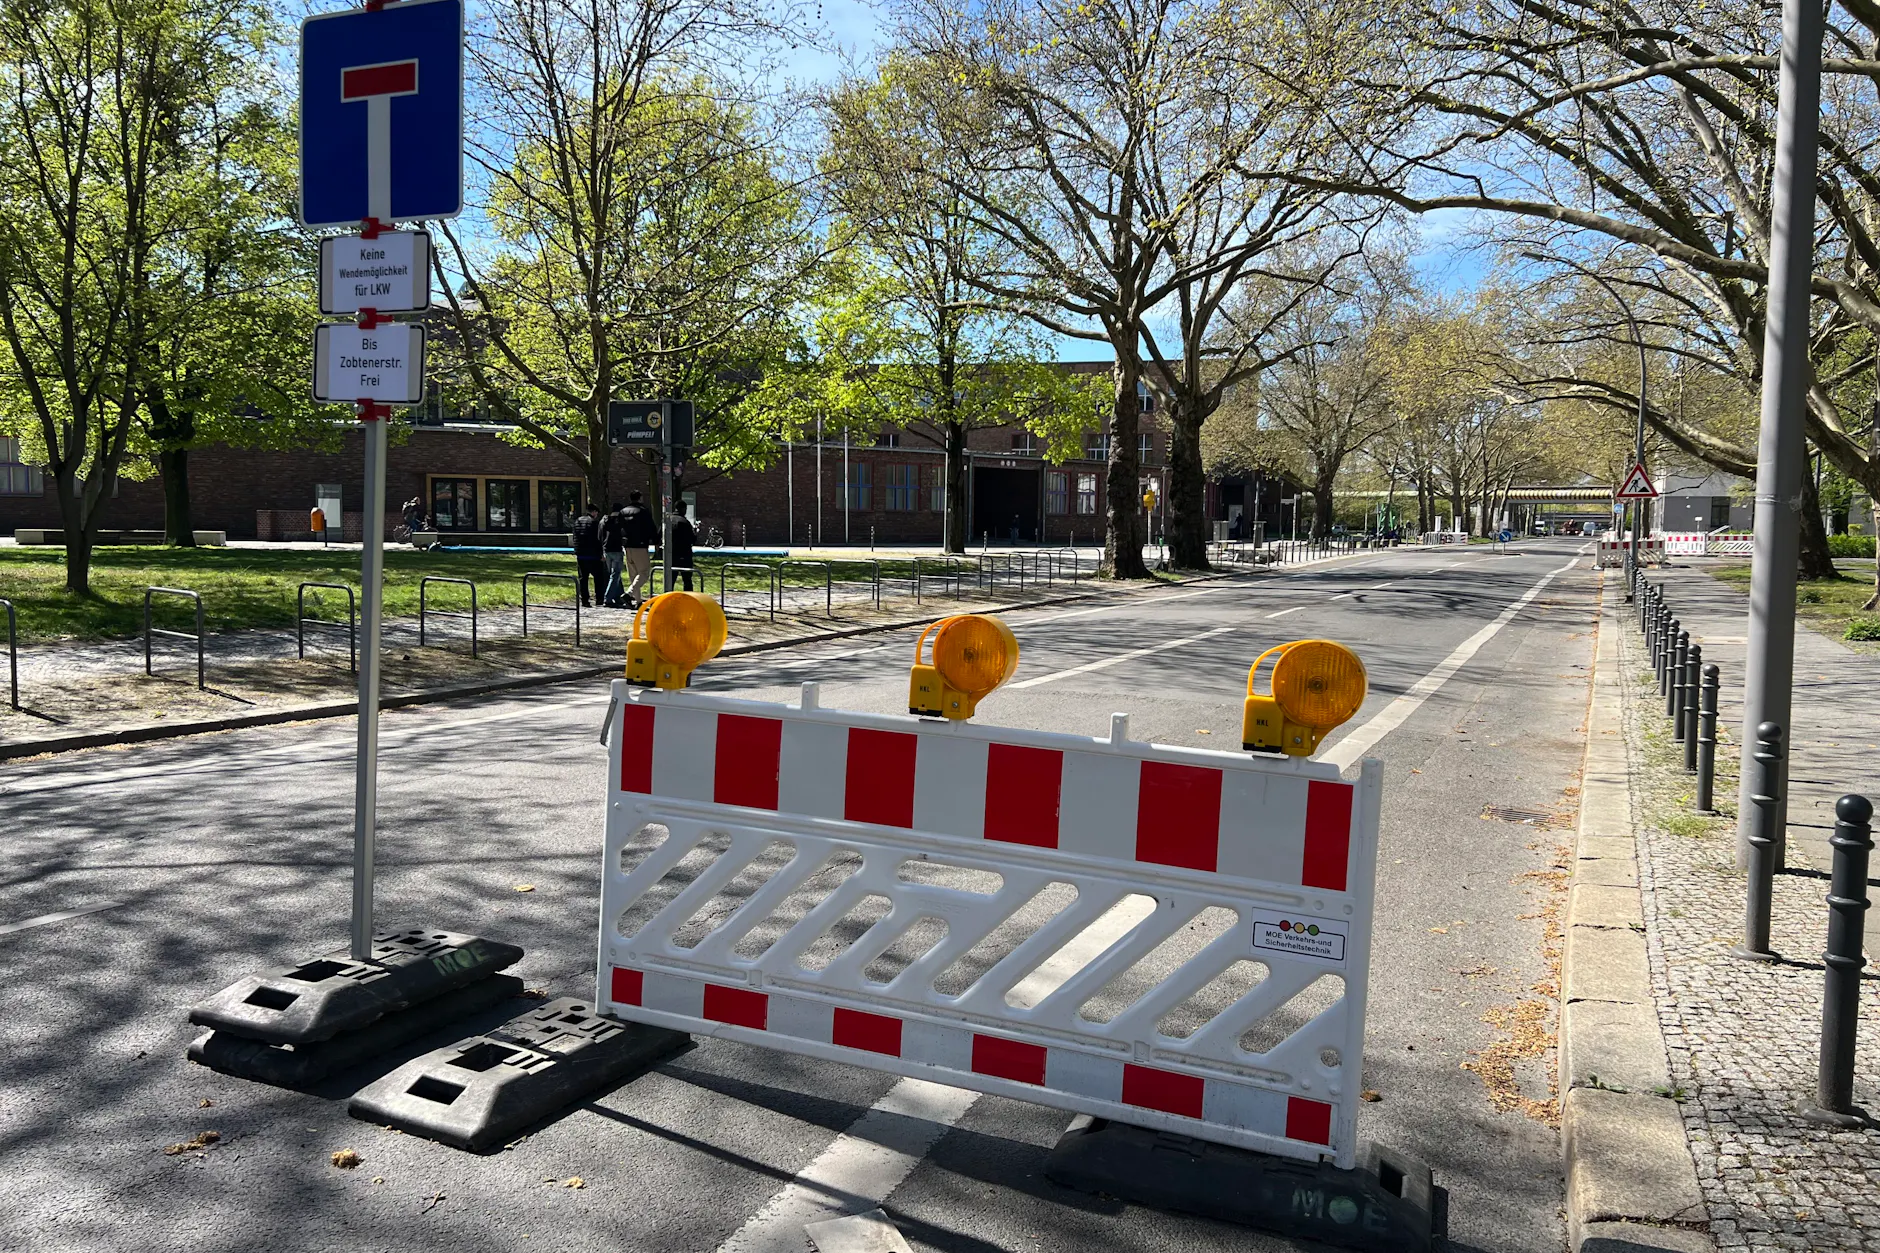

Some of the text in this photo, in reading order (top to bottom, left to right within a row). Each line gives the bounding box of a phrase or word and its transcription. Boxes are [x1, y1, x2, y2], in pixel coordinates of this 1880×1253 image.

[360, 249, 386, 260] Keine
[340, 265, 408, 279] Wendemöglichkeit
[355, 284, 391, 296] für LKW
[362, 338, 378, 350] Bis
[340, 356, 402, 368] Zobtenerstr.
[360, 374, 380, 386] Frei
[1256, 718, 1268, 727] HKL
[1266, 931, 1282, 940] MOE
[1265, 939, 1332, 954] Sicherheitstechnik
[432, 944, 489, 976] MOE
[1292, 1187, 1388, 1230] MOE
